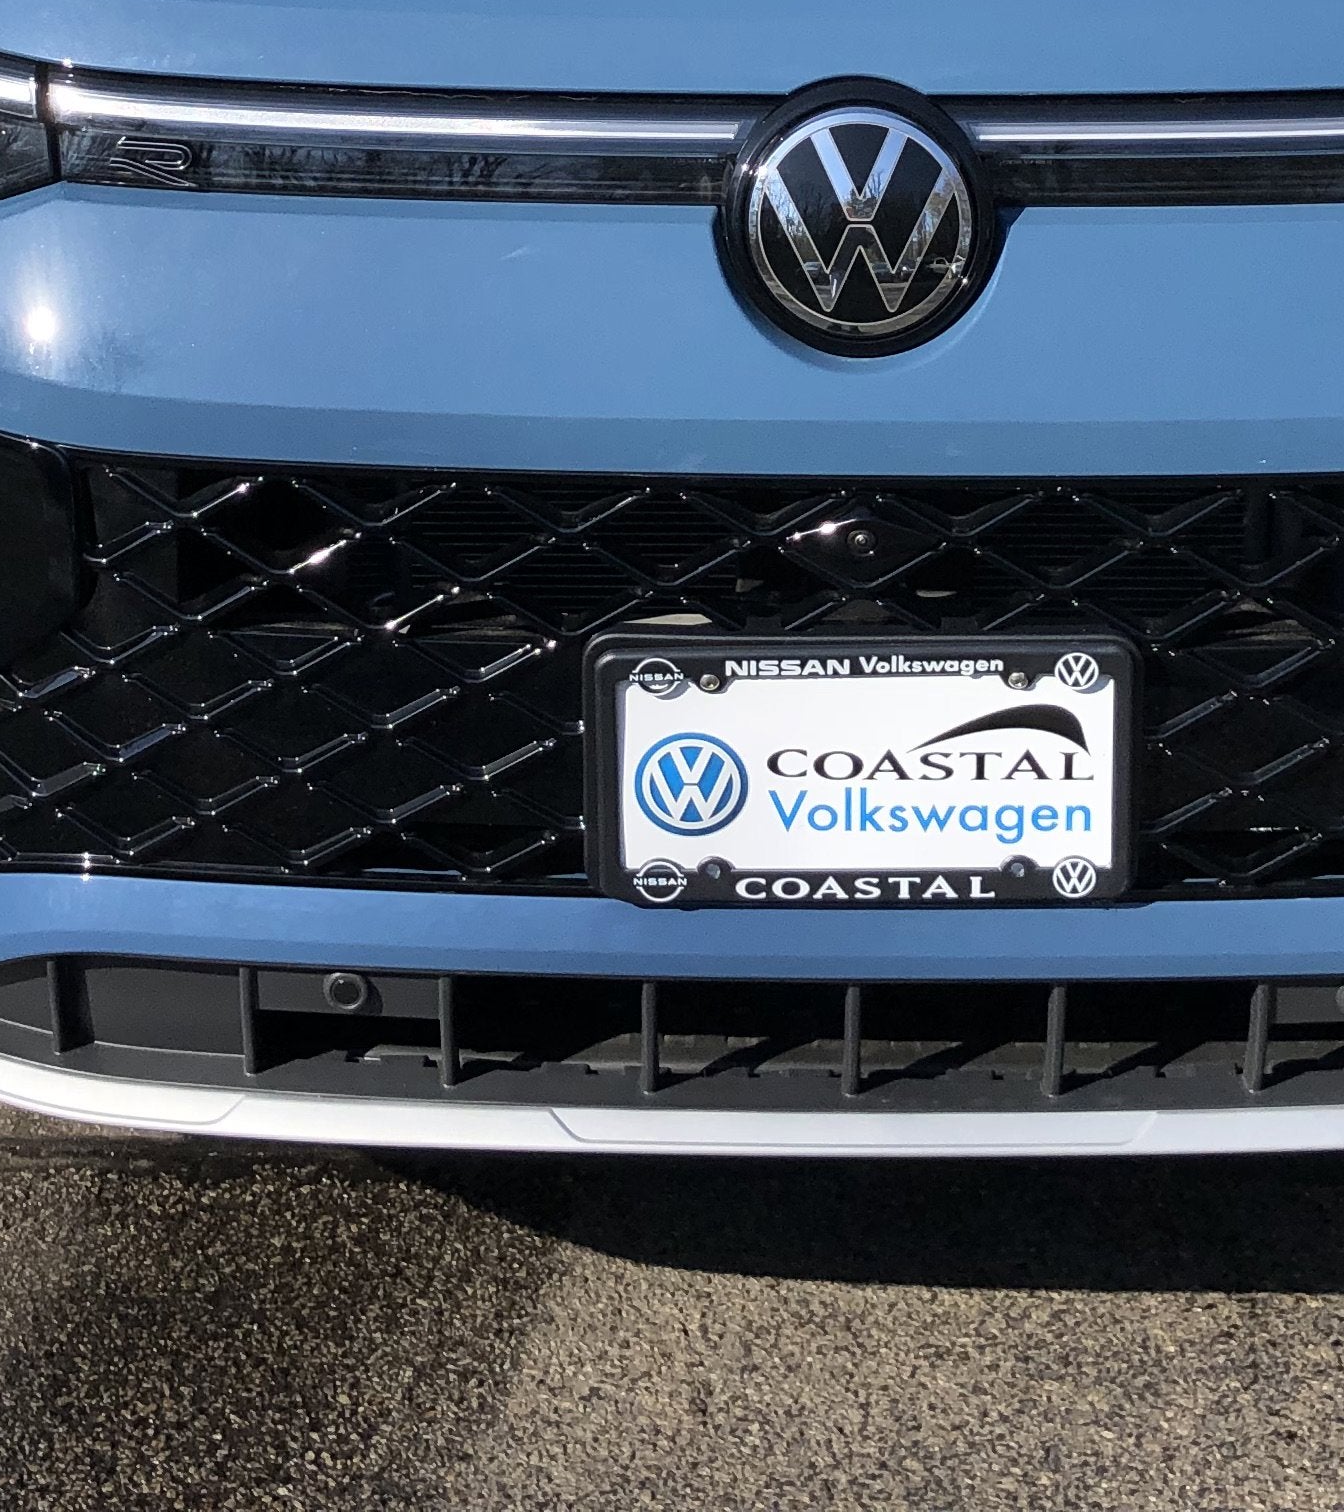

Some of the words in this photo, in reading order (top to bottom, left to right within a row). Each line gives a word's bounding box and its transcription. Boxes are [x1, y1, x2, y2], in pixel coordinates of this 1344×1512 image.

[629, 672, 684, 682] NISSAN
[725, 659, 850, 677] NISSAN
[859, 655, 1003, 675] Volkswagen
[766, 748, 1095, 781] COASTAL
[768, 786, 1092, 844] Volkswagen
[633, 876, 687, 887] NISSAN
[735, 875, 996, 900] COASTAL
